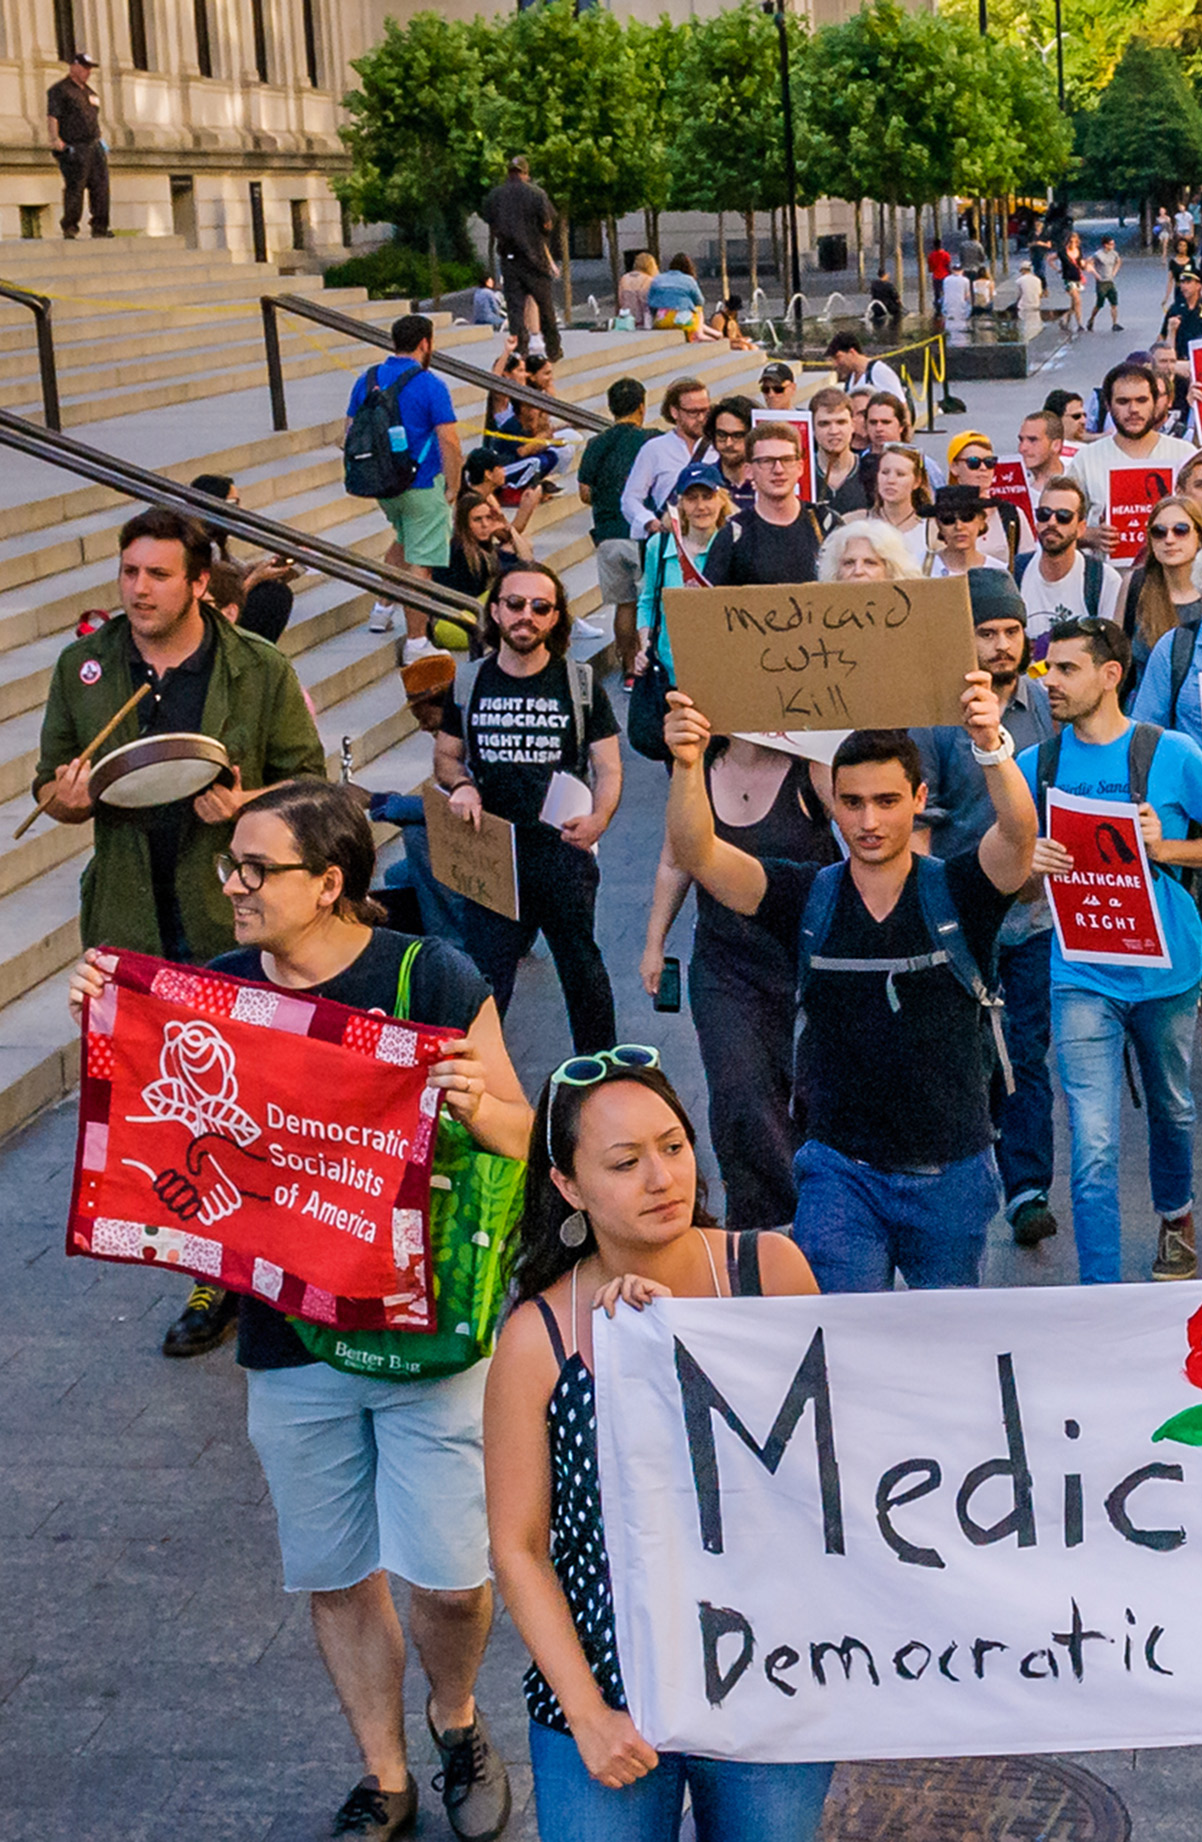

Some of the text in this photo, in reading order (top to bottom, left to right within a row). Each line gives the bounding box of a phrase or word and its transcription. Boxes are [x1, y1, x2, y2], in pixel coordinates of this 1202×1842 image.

[1112, 504, 1152, 514] HEALTHC
[1120, 532, 1145, 542] RIG
[480, 697, 559, 712] FIGHT FOR
[471, 712, 570, 728] DEMOCRACY
[477, 733, 560, 748] FIGHT FOR
[479, 748, 562, 763] SOCIALISM
[1096, 780, 1130, 794] Sand
[1053, 871, 1141, 889] HEALTHCARE
[1082, 893, 1122, 908] is a
[1076, 913, 1136, 930] RIGHT
[267, 1102, 409, 1159] Democratic
[269, 1143, 384, 1197] Socialists
[274, 1184, 377, 1243] of America
[335, 1341, 385, 1366] Better
[698, 1597, 1173, 1708] Democratic
